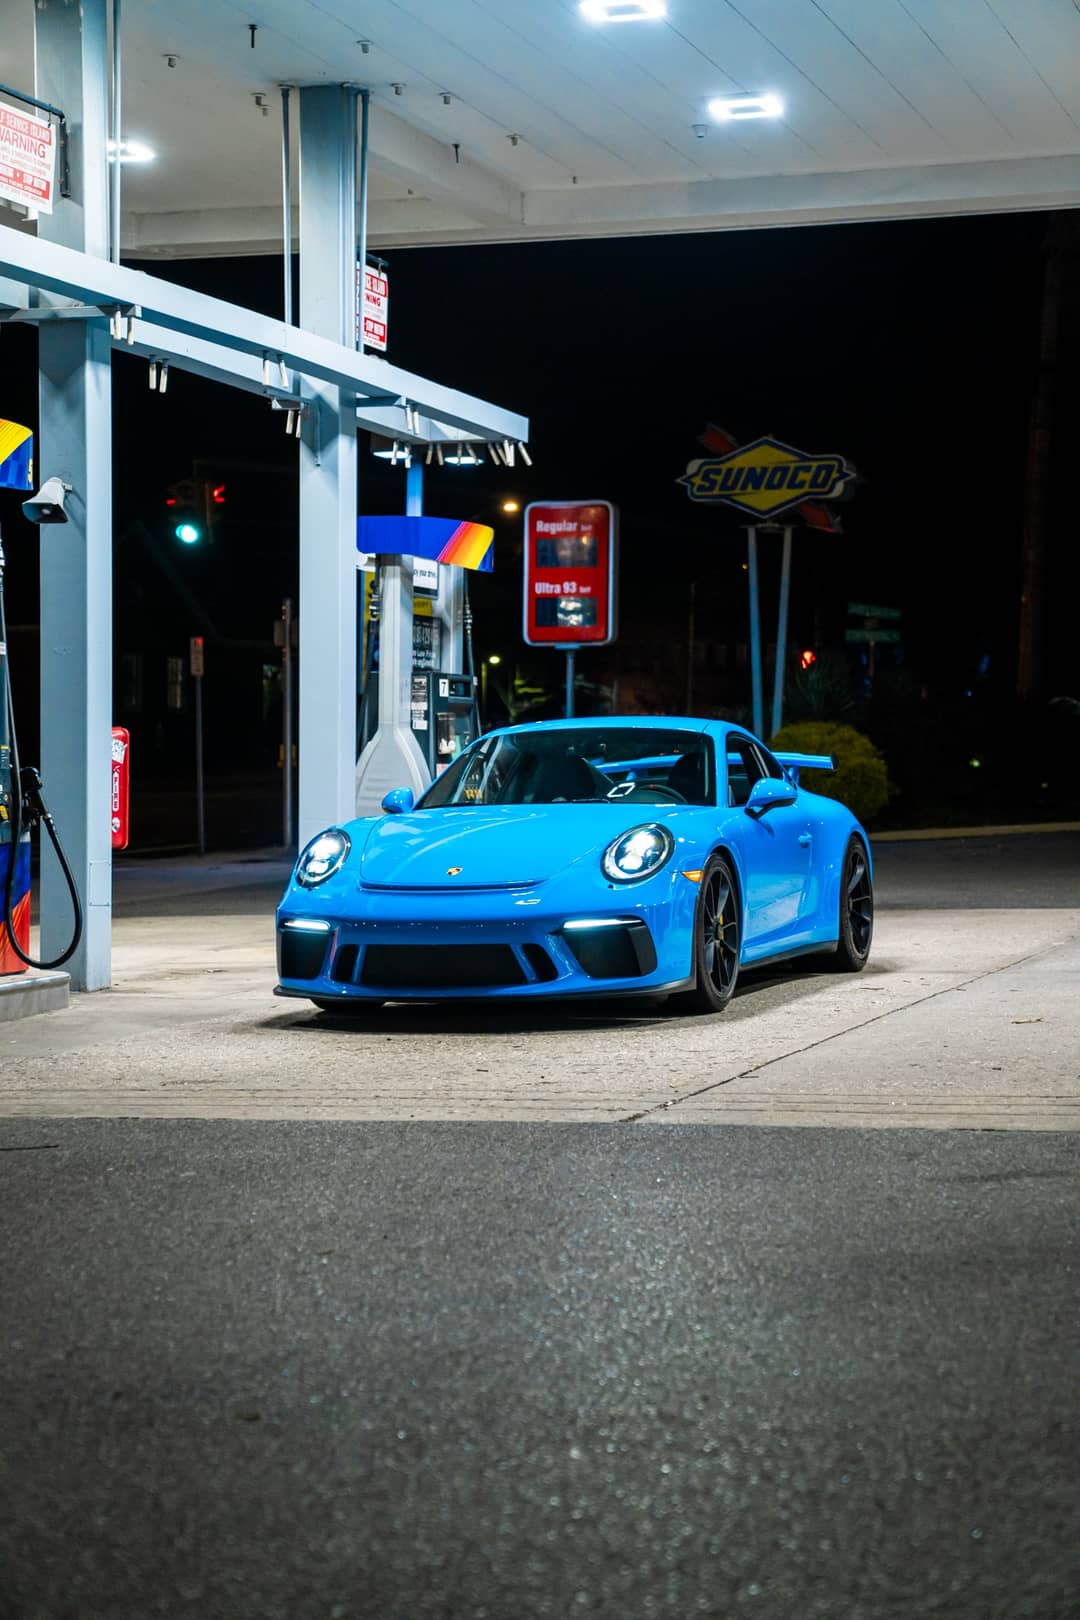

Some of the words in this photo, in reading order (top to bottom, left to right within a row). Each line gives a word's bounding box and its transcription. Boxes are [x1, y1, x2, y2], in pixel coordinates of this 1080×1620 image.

[697, 463, 836, 493] SUNOCO
[536, 520, 577, 535] Regular
[534, 582, 561, 594] Ultra
[562, 581, 577, 594] 93
[441, 681, 447, 694] 7
